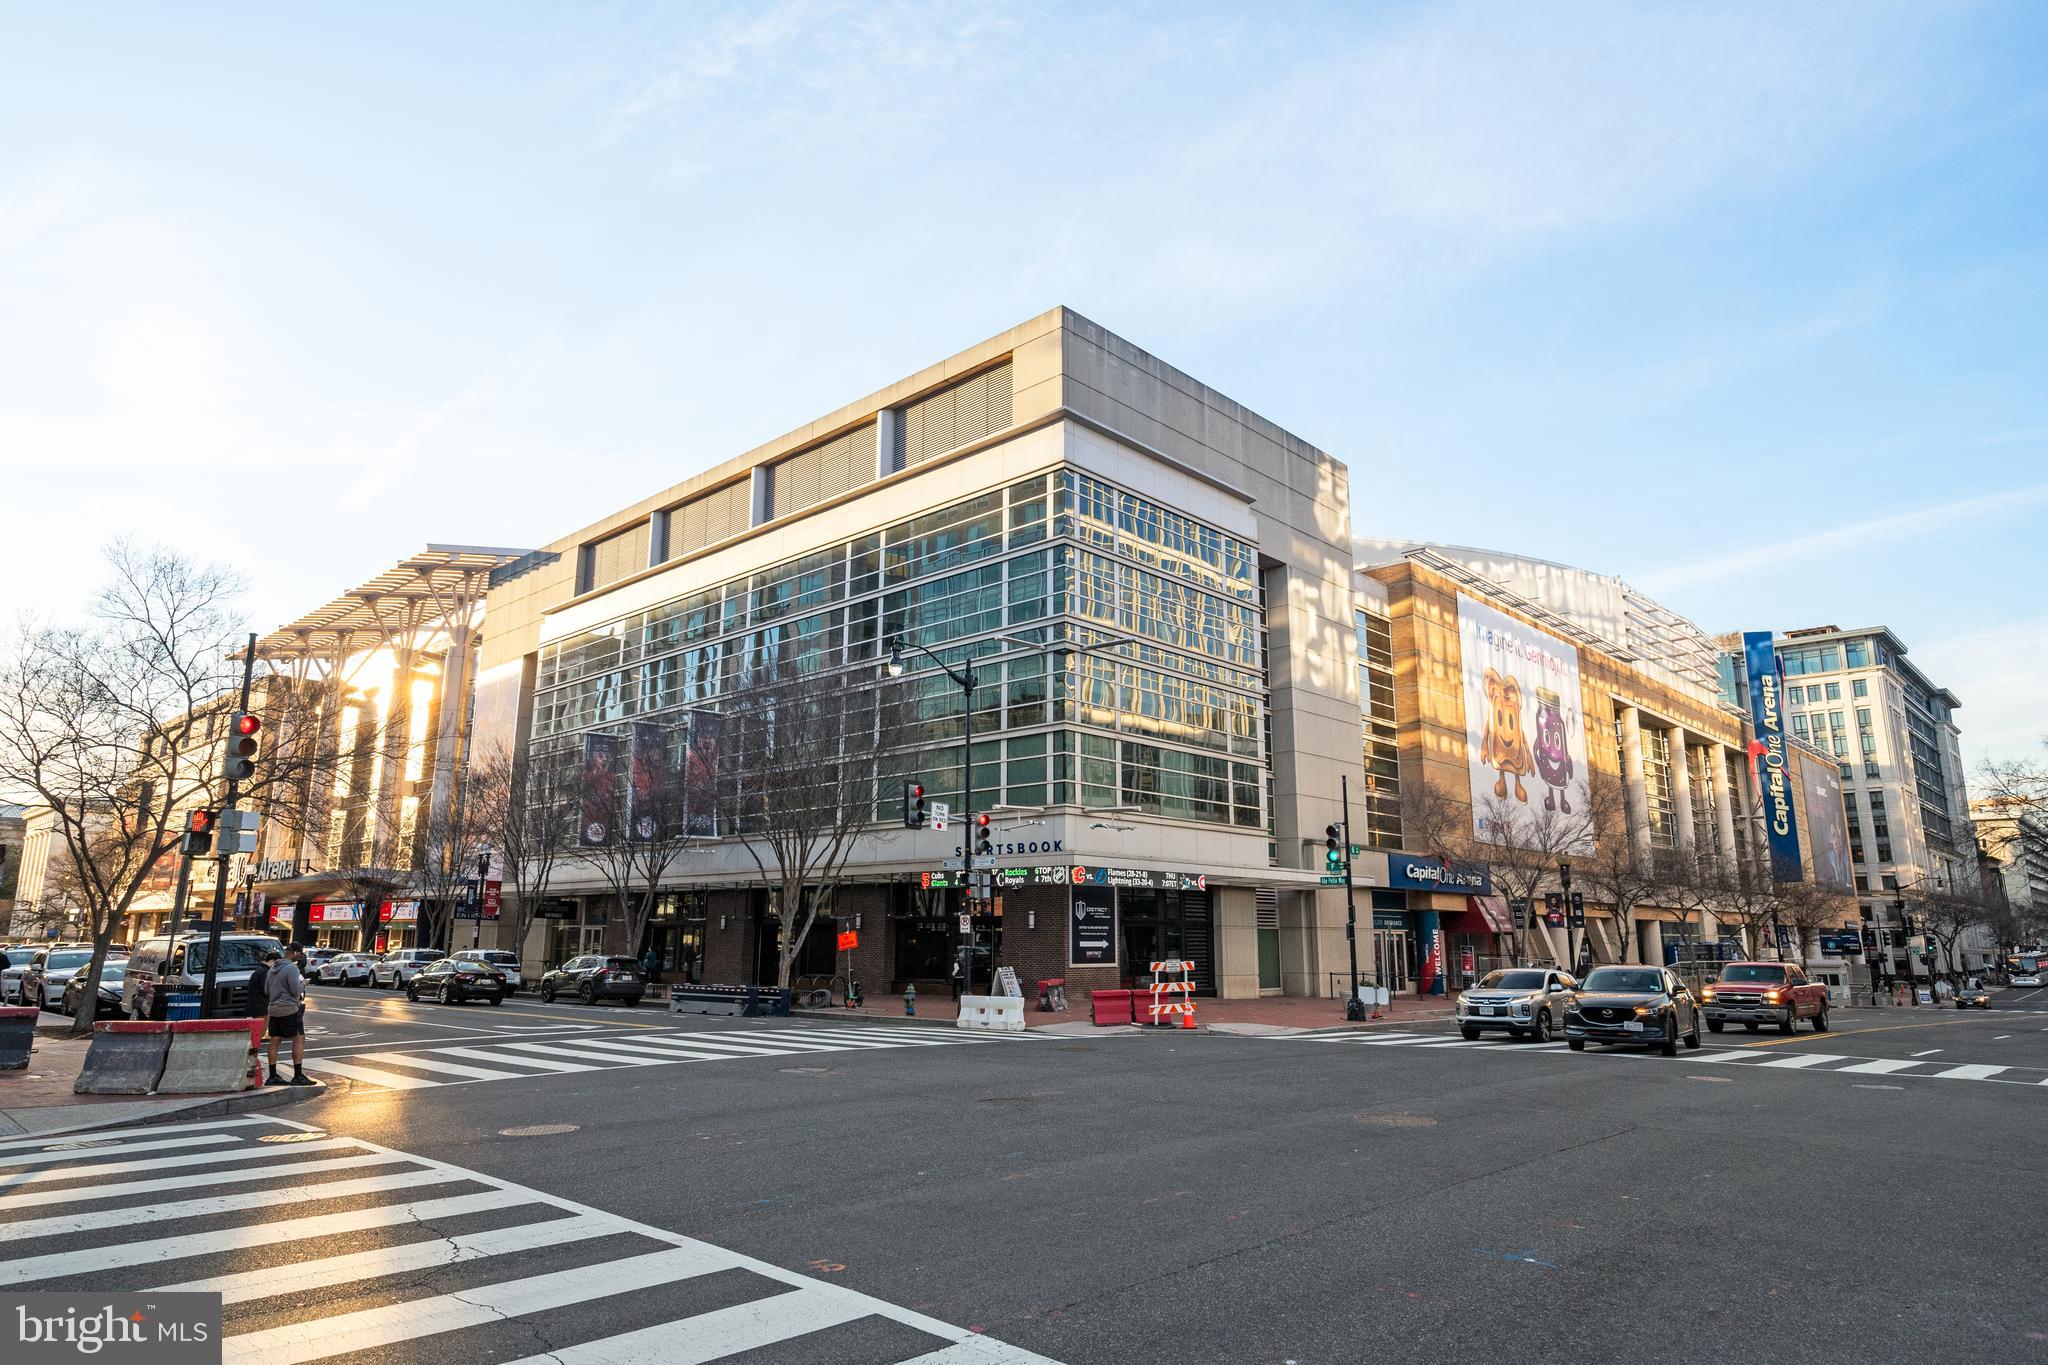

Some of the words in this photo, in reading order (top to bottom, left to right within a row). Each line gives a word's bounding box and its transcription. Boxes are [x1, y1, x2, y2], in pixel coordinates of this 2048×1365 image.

[1761, 675, 1779, 732] Arena
[257, 858, 296, 880] Arena
[1005, 868, 1028, 876] Rockies
[1107, 868, 1127, 877] Flames
[931, 872, 945, 880] Cubs
[1005, 876, 1025, 884] Royals
[1034, 875, 1039, 883] 4
[1041, 875, 1051, 883] 7th
[1165, 872, 1176, 880] THU
[931, 879, 949, 887] Giants
[1107, 876, 1132, 887] Lightning
[1432, 928, 1442, 975] WELCOME
